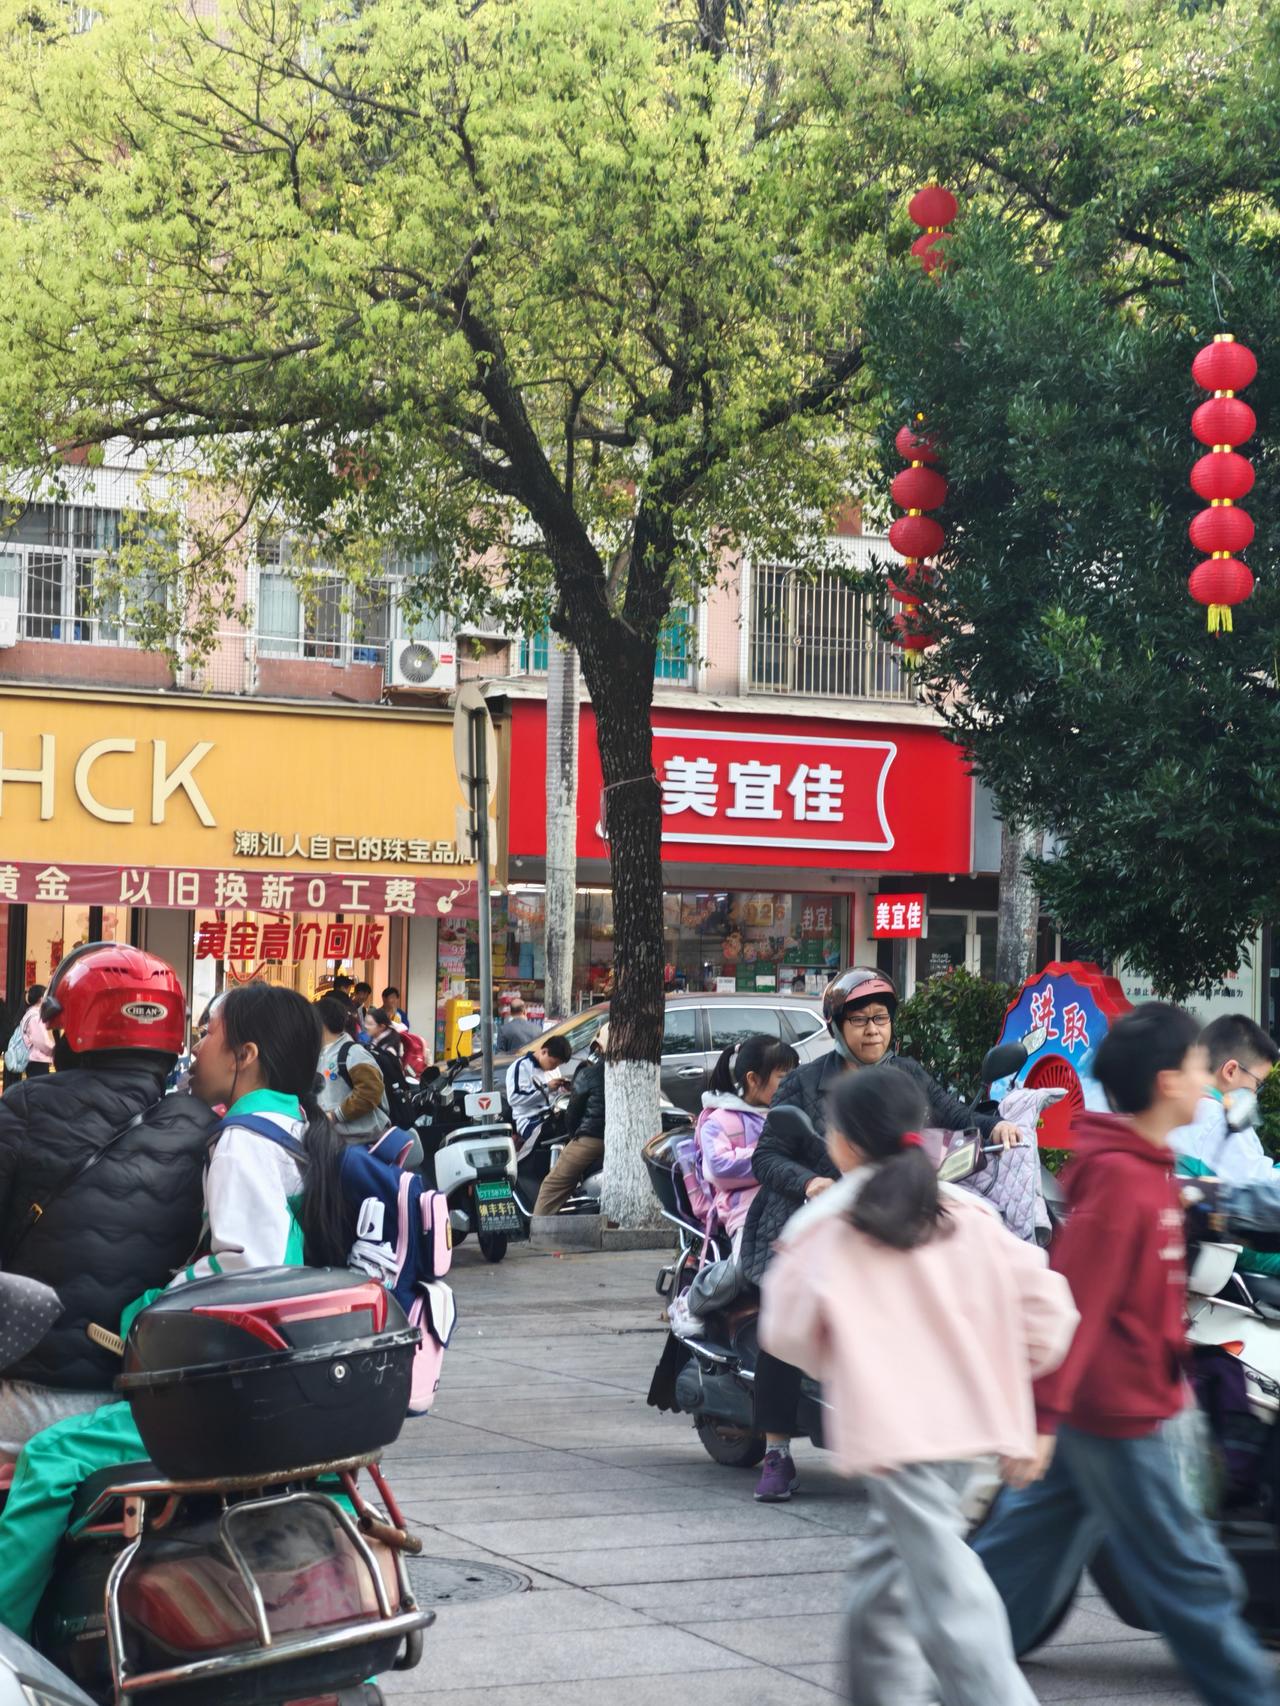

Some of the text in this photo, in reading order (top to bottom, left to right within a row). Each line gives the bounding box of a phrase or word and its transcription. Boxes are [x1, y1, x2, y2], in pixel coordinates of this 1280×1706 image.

[0, 731, 217, 828] HCK
[661, 756, 845, 822] 美宜佳
[119, 869, 416, 914] 以旧换新0工费
[876, 901, 921, 931] 美宜佳
[195, 921, 384, 960] 黄金高价回收
[1030, 984, 1089, 1054] 进取
